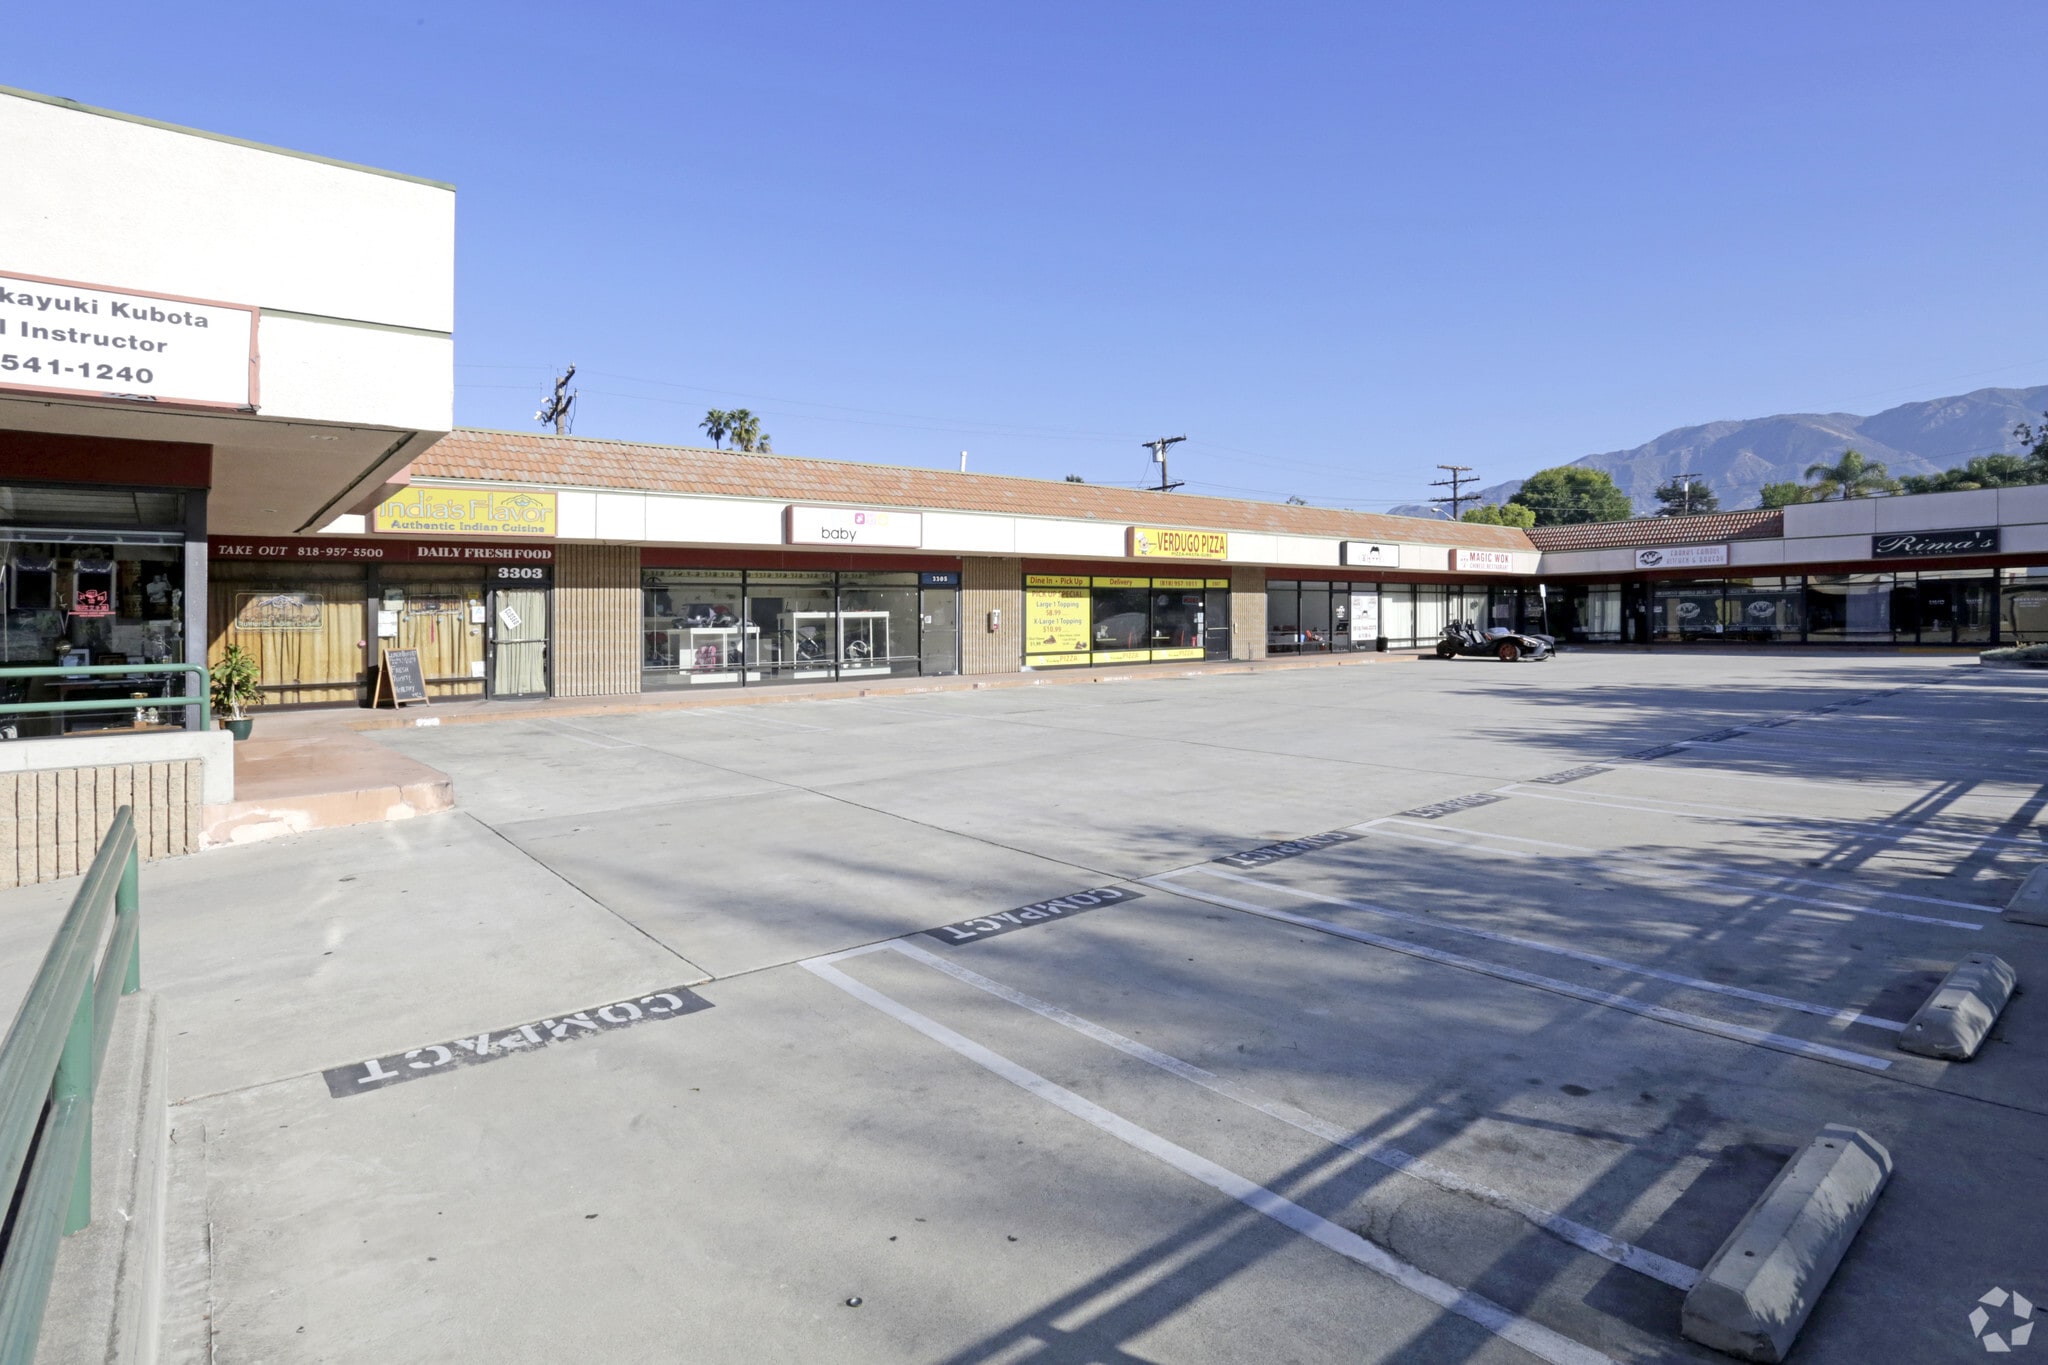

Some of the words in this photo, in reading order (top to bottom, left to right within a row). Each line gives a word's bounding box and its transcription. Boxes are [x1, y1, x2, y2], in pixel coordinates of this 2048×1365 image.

[110, 301, 209, 328] Kubota
[21, 321, 168, 353] Instructor
[0, 354, 154, 384] 541-1240
[379, 489, 465, 520] India's
[468, 493, 553, 523] Flavor
[391, 520, 455, 531] Authentic
[459, 521, 498, 532] Indian
[502, 523, 545, 533] Cuisine
[821, 526, 857, 543] baby
[1876, 531, 1994, 553] Rima's
[1157, 532, 1200, 553] VERDUGO
[1201, 535, 1225, 554] PIZZA
[218, 545, 253, 555] TAKE
[258, 545, 288, 556] OUT
[297, 546, 383, 558] 818-957-5500
[417, 546, 462, 558] DAILY
[464, 547, 513, 559] FRESH
[514, 549, 552, 560] FOOD
[1469, 552, 1493, 563] MAGIC
[1494, 554, 1509, 563] WOK
[497, 567, 543, 579] 3303
[1030, 576, 1045, 584] Dine
[1046, 576, 1053, 584] In
[1060, 577, 1073, 585] Pick
[1074, 578, 1083, 586] Up
[1110, 578, 1132, 587] Delivery
[1031, 590, 1048, 598] PICK
[1048, 590, 1057, 598] UP
[1059, 590, 1082, 598] SPECIAL
[1057, 601, 1079, 609] Topping
[1060, 617, 1082, 625] Topping
[1228, 831, 1349, 867] COMPACT
[942, 887, 1124, 940] COMPACT
[357, 992, 684, 1085] COMPACT
